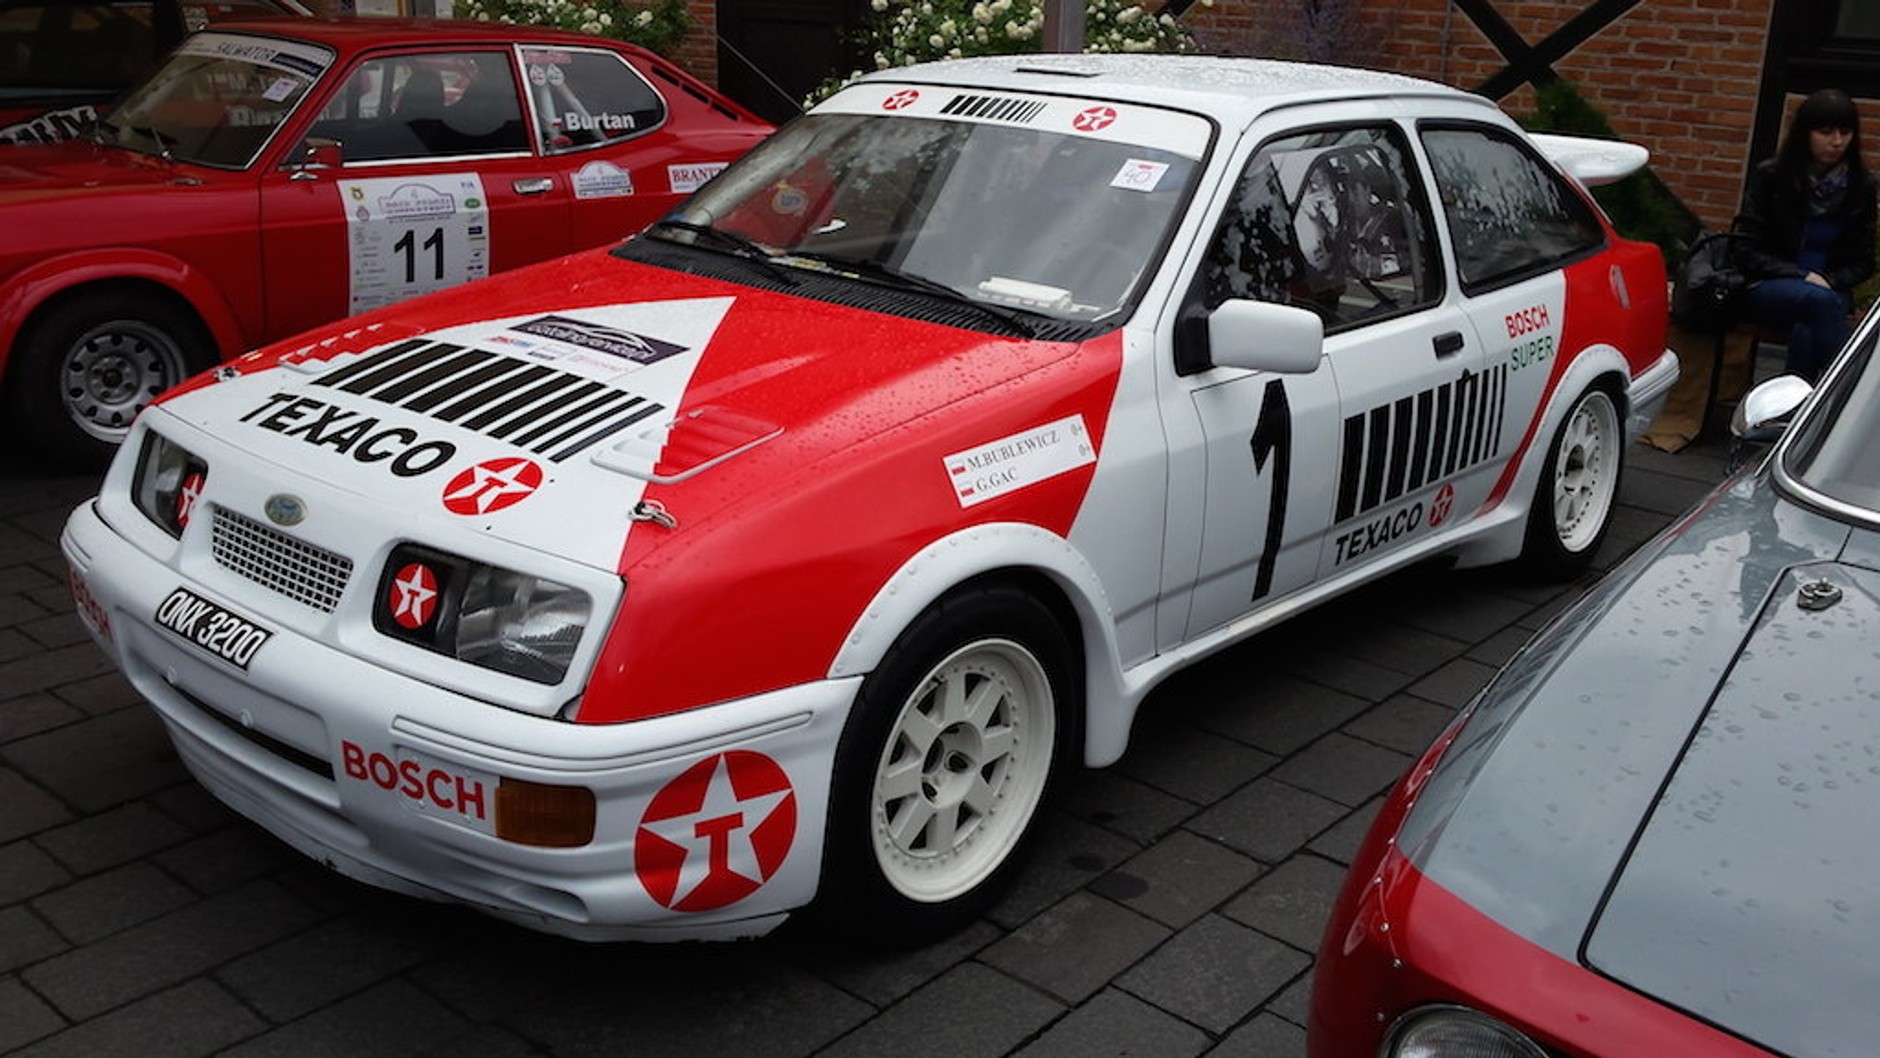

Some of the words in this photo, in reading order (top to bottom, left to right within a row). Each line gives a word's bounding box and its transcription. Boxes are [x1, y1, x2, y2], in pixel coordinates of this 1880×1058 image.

[564, 112, 635, 131] Burtan
[394, 227, 443, 283] 11
[1505, 304, 1549, 338] BOSCH
[1511, 336, 1555, 371] SUPER
[238, 393, 456, 477] TEXACO
[967, 430, 1060, 471] M.BUBLEWICZ
[976, 467, 1020, 492] G.GAC
[1250, 378, 1291, 601] 1
[1335, 502, 1423, 566] TEXACO
[197, 611, 266, 667] 3200
[341, 739, 487, 820] BOSCH
